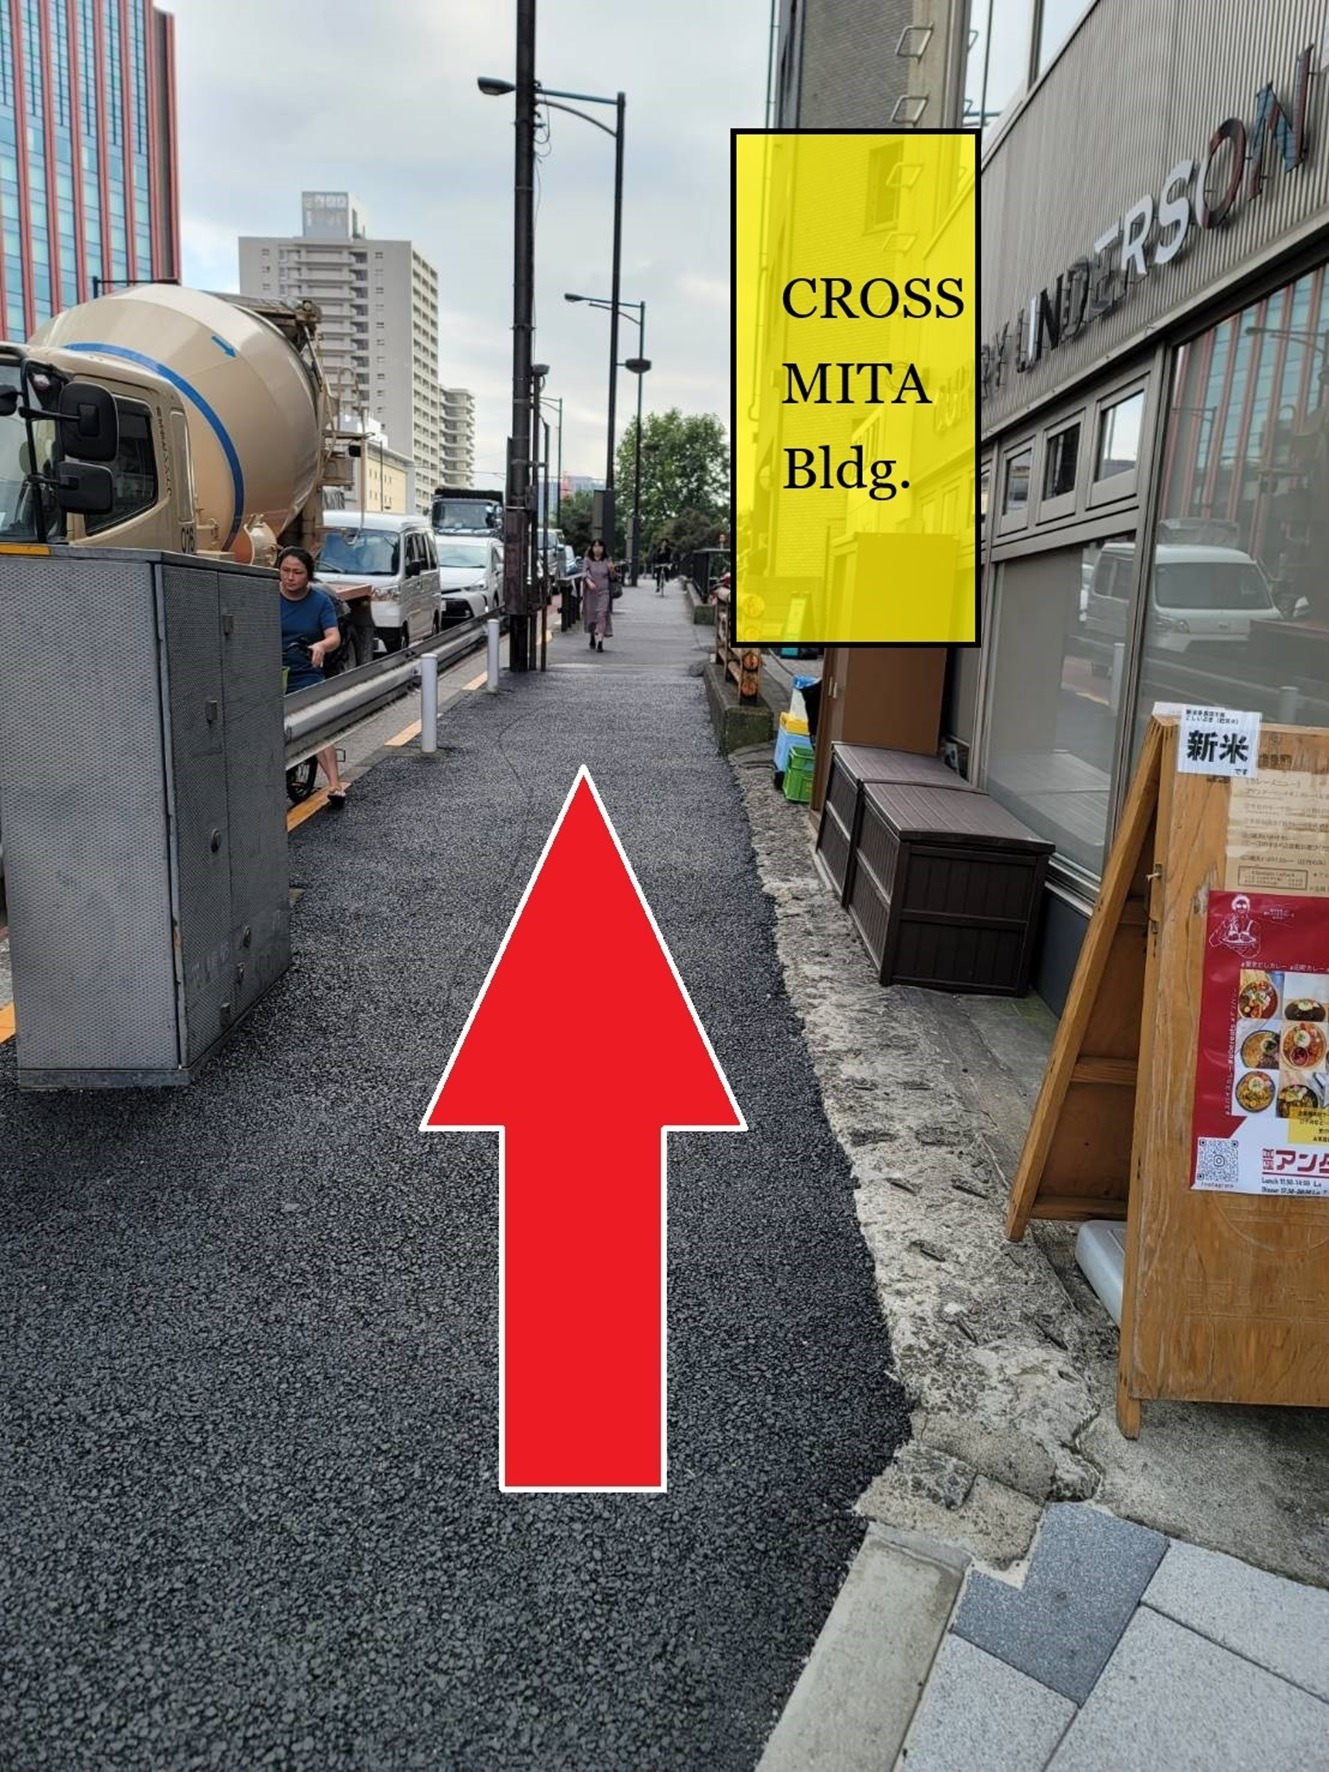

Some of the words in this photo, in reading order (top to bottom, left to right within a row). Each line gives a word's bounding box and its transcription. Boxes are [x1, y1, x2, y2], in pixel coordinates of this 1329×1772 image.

[1016, 43, 1315, 374] UNDERSON
[1187, 729, 1249, 764] 新米
[1235, 768, 1248, 776] です
